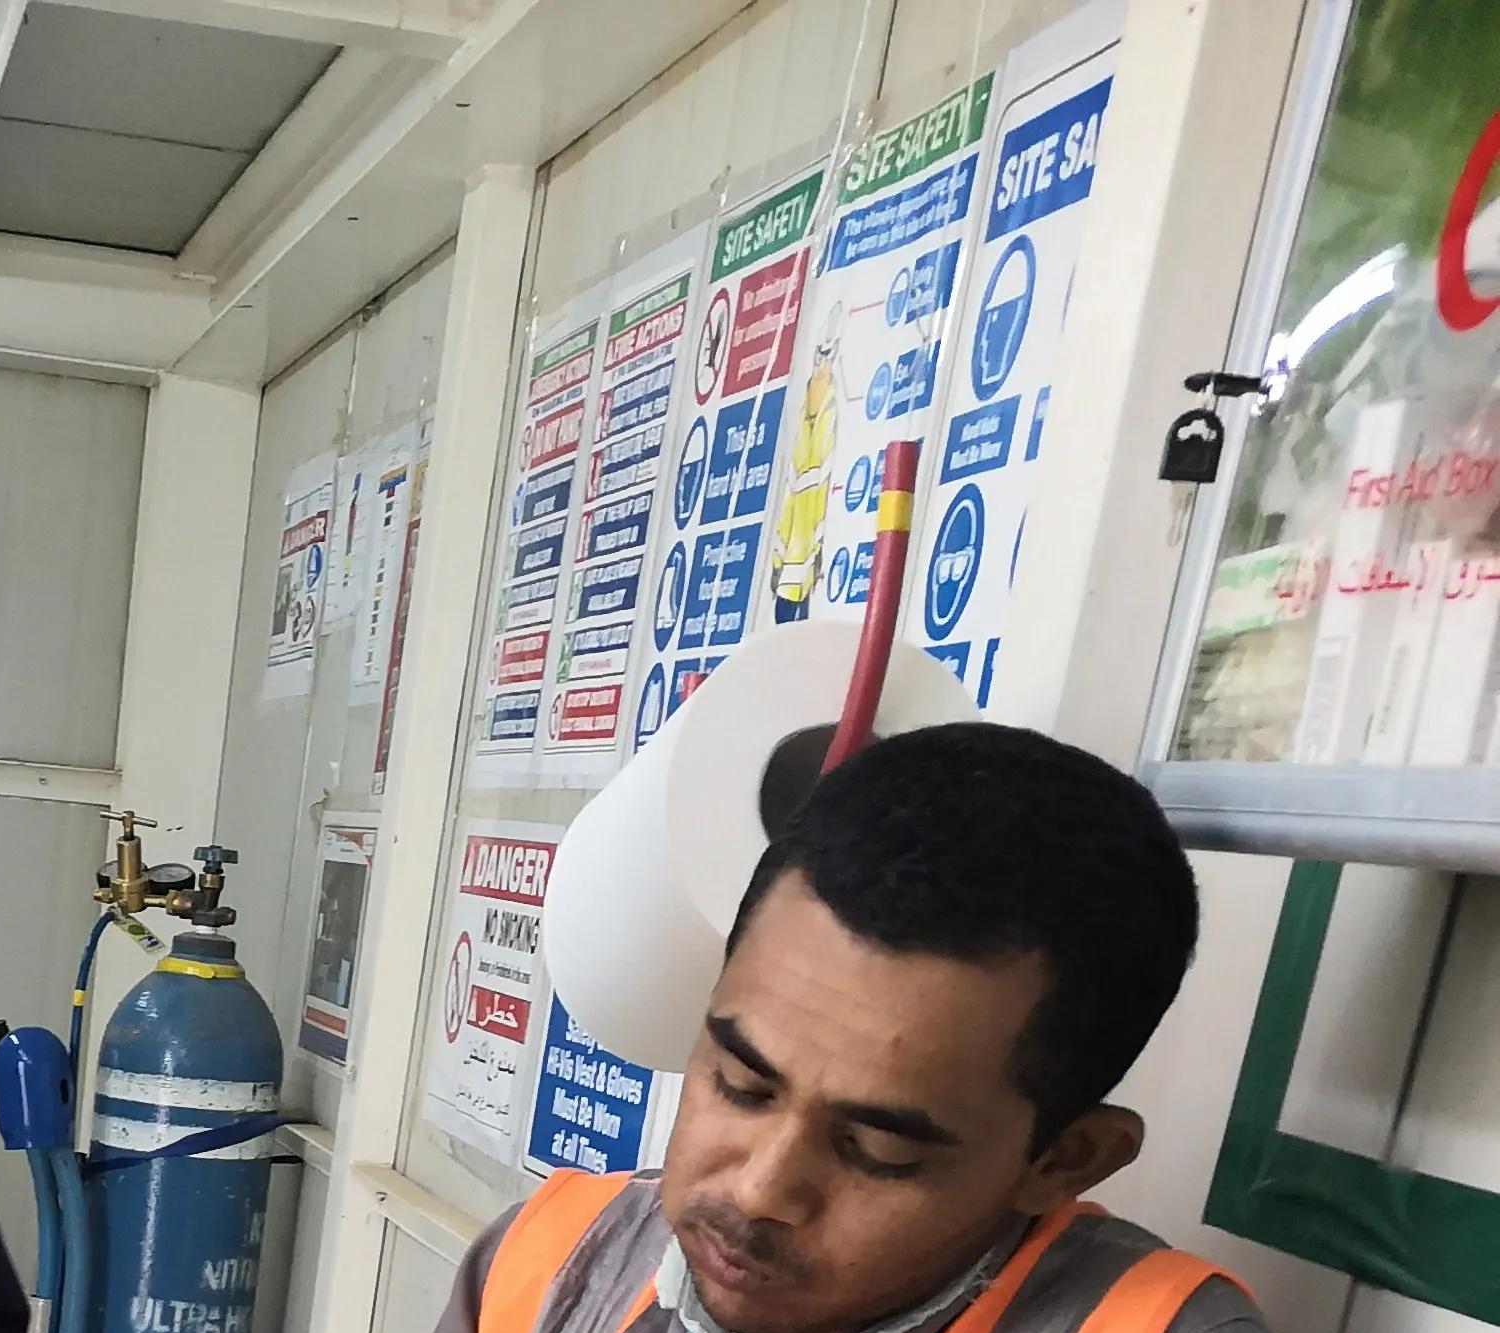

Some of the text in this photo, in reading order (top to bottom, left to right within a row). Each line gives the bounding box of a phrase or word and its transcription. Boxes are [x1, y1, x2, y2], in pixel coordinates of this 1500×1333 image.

[997, 132, 1061, 211] SITE
[722, 190, 810, 266] SITE SAFETY
[473, 844, 550, 897] DANGER
[478, 993, 518, 1028] خطر
